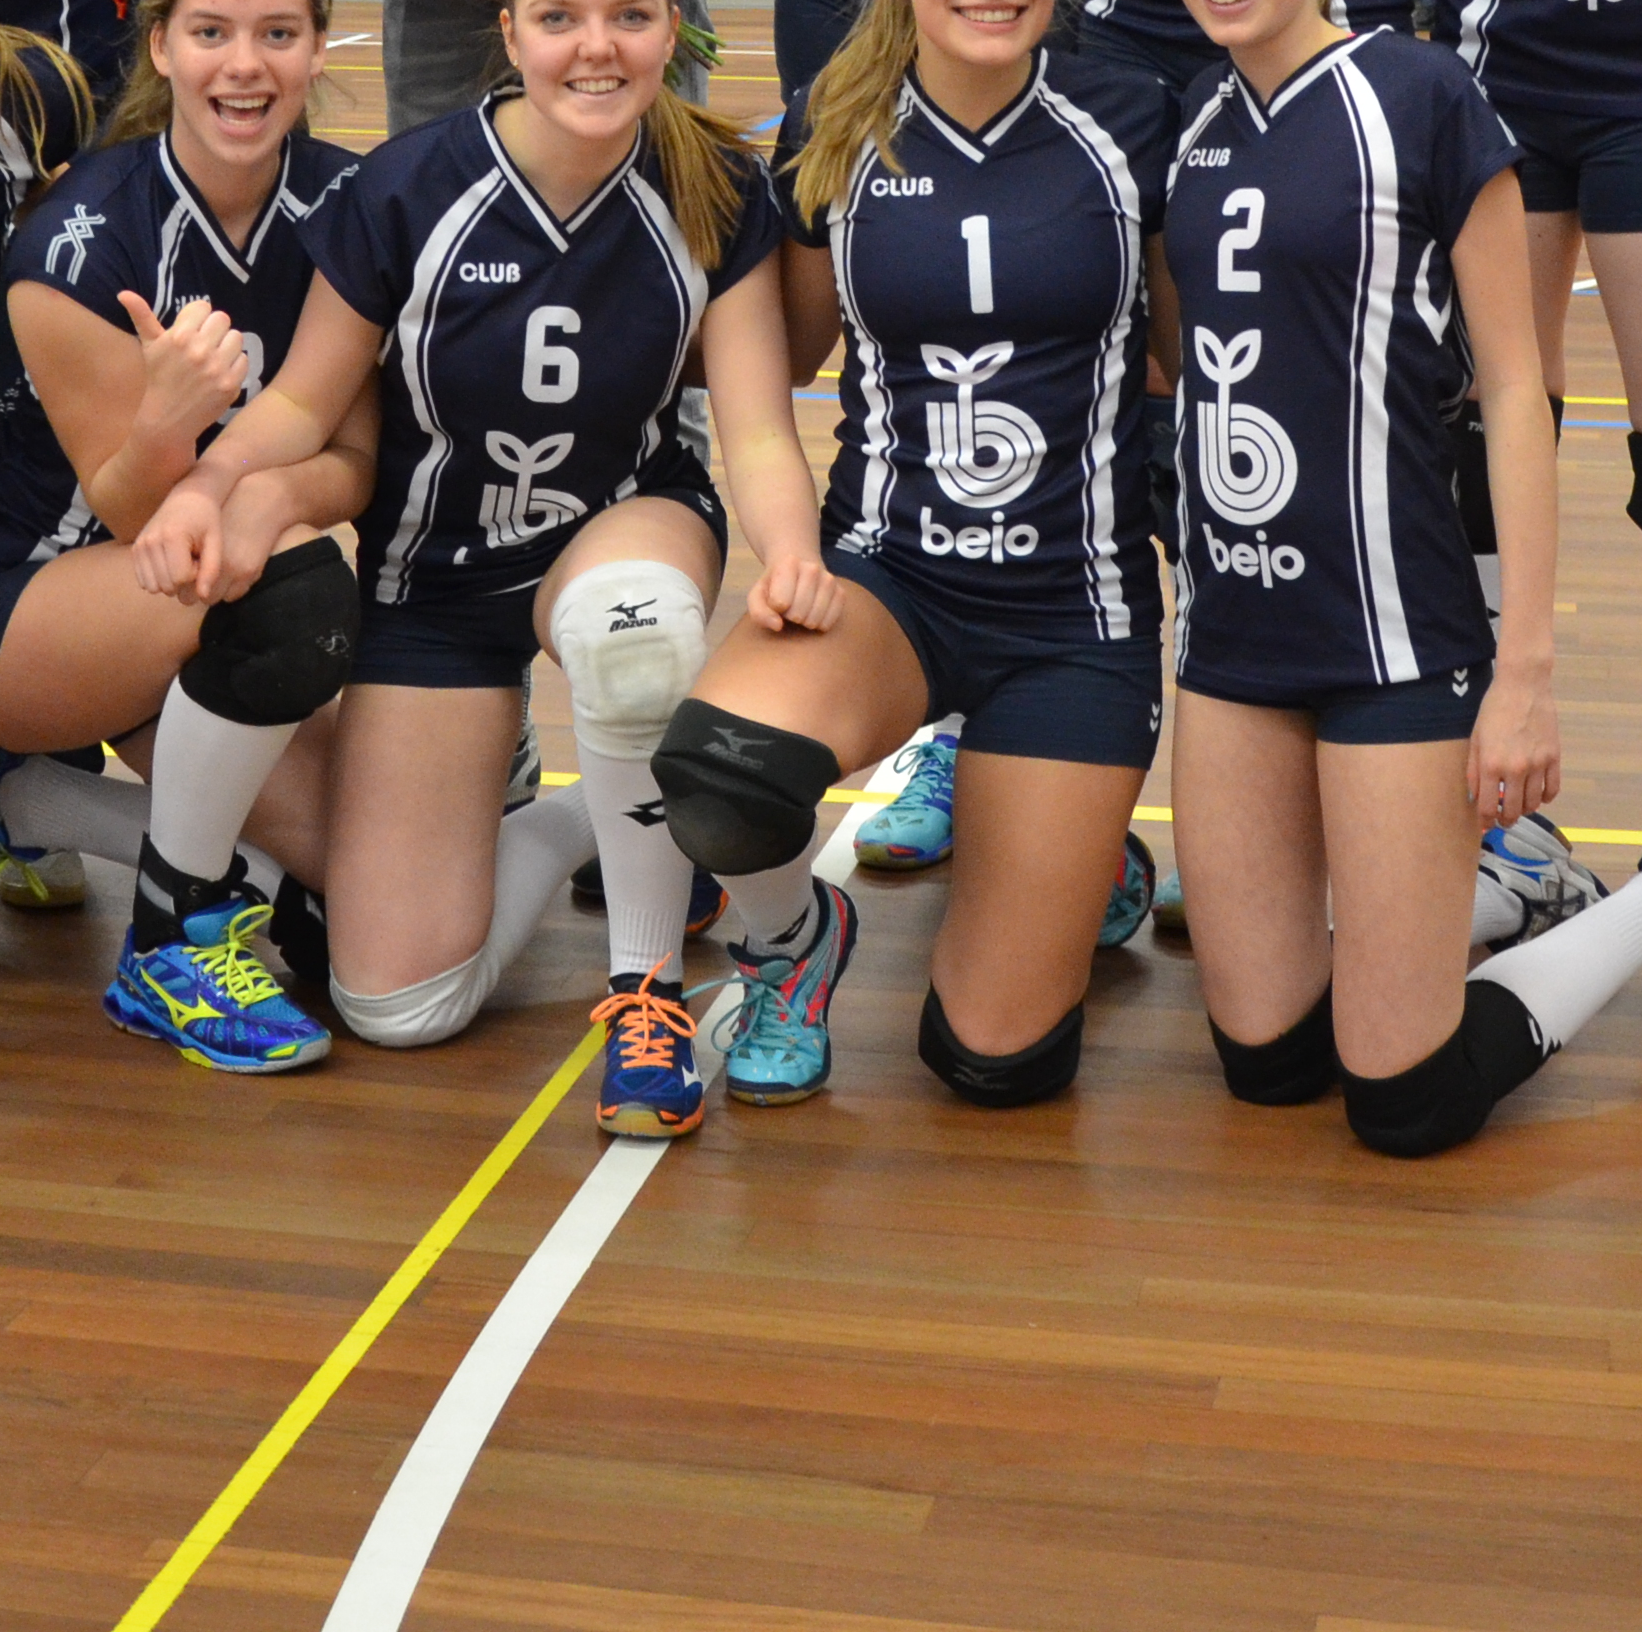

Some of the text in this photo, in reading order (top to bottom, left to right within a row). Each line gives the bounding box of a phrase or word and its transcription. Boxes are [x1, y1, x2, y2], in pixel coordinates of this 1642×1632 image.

[870, 175, 934, 197] CLUB
[1187, 146, 1231, 168] CLUB
[960, 214, 994, 314] 1
[1217, 187, 1266, 293] 2
[459, 262, 521, 284] CLUB
[521, 305, 581, 404] 6
[919, 505, 1040, 564] bejo
[1202, 523, 1306, 589] bejo
